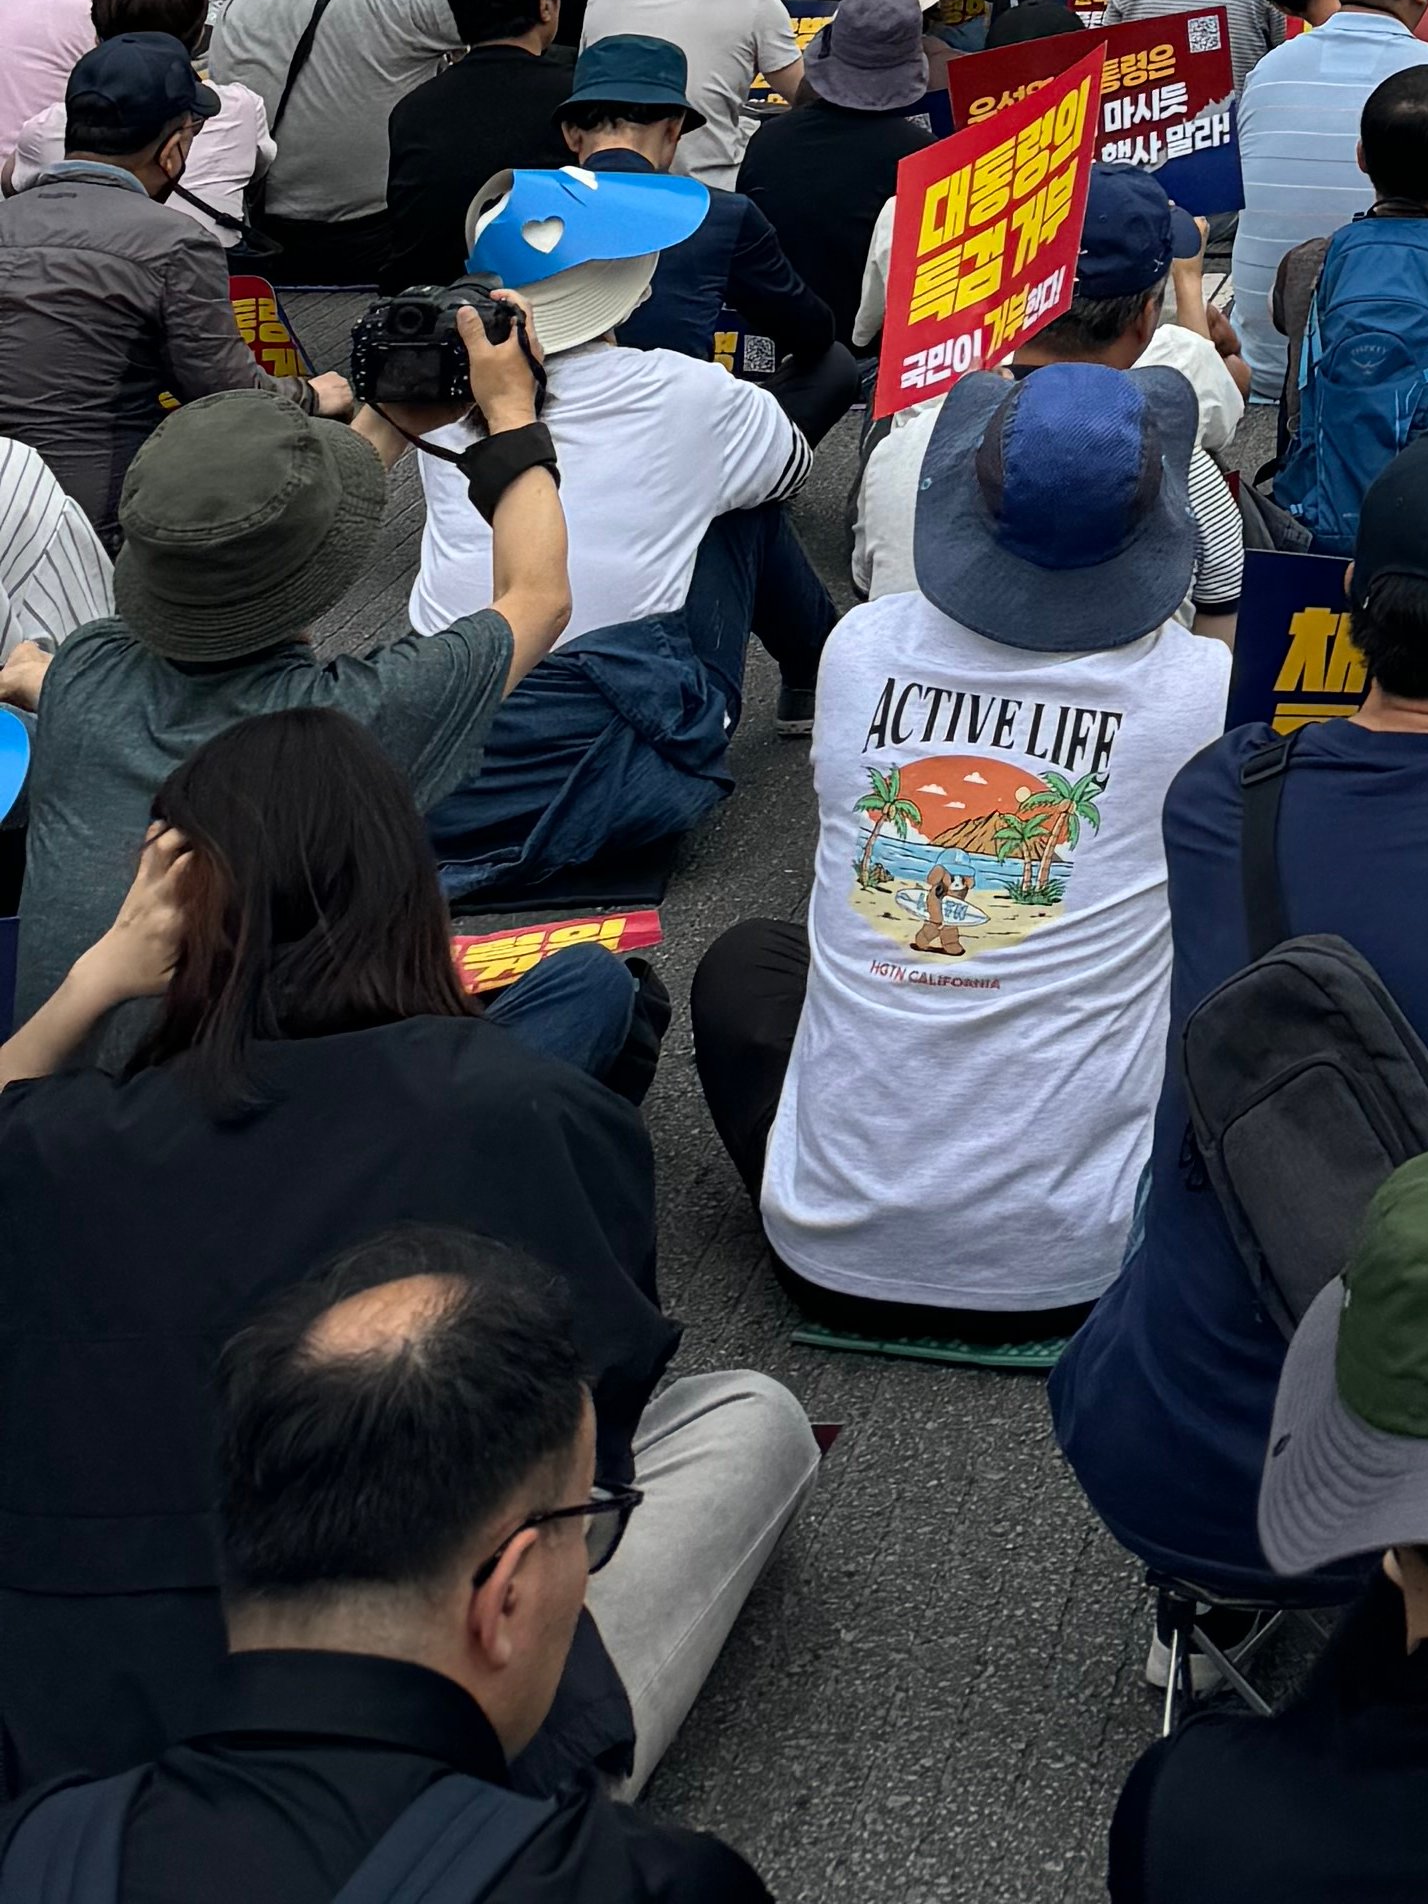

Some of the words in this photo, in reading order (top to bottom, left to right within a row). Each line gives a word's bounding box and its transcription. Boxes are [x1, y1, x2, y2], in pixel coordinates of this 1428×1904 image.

[1100, 43, 1177, 96] 통령은
[1104, 82, 1189, 129] 마시듯
[915, 72, 1093, 257] 대통령의
[1165, 111, 1232, 161] 말라!
[908, 222, 1008, 326] 특검
[1010, 161, 1080, 277] 거부
[899, 327, 984, 391] 국민이
[983, 265, 1067, 354] 거부한다!
[860, 676, 1023, 756] ACTIVE
[1024, 701, 1124, 790] LIFE
[908, 968, 1002, 992] CALIFORNIA
